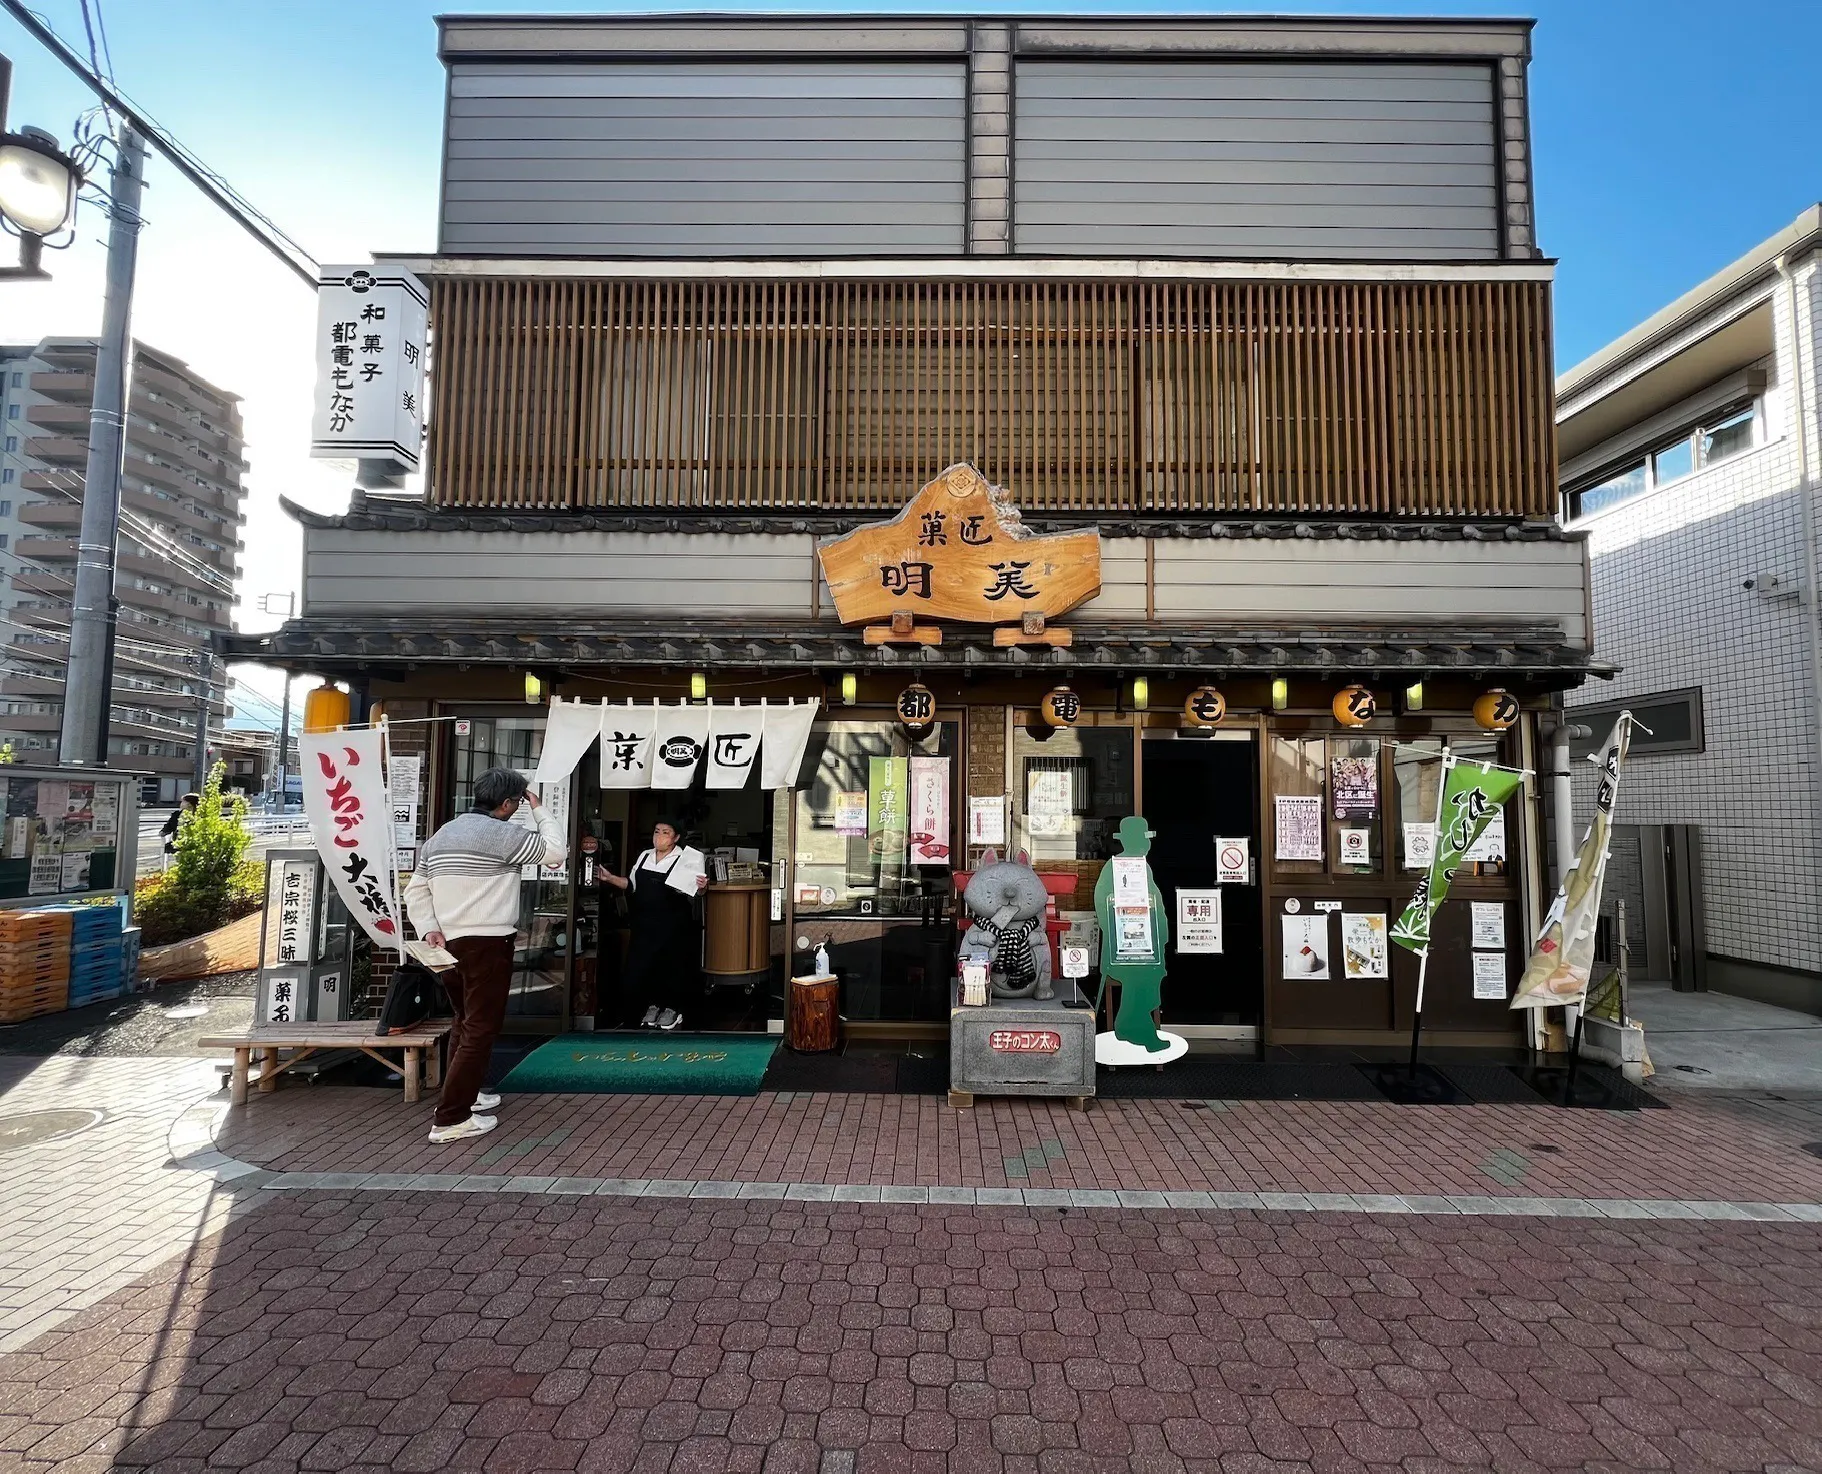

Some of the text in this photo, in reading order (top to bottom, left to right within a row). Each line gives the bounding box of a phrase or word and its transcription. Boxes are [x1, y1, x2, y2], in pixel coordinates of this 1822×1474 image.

[360, 303, 385, 382] 和菓子
[329, 321, 358, 433] 都電もなか
[919, 510, 993, 547] 菓匠
[900, 690, 932, 718] 都
[1050, 693, 1080, 722] 電
[1191, 692, 1223, 721] も
[1348, 690, 1376, 720] な
[879, 789, 897, 824] 草餅
[1186, 904, 1211, 917] 専用
[992, 1032, 1060, 1050] 王子のコン太くん
